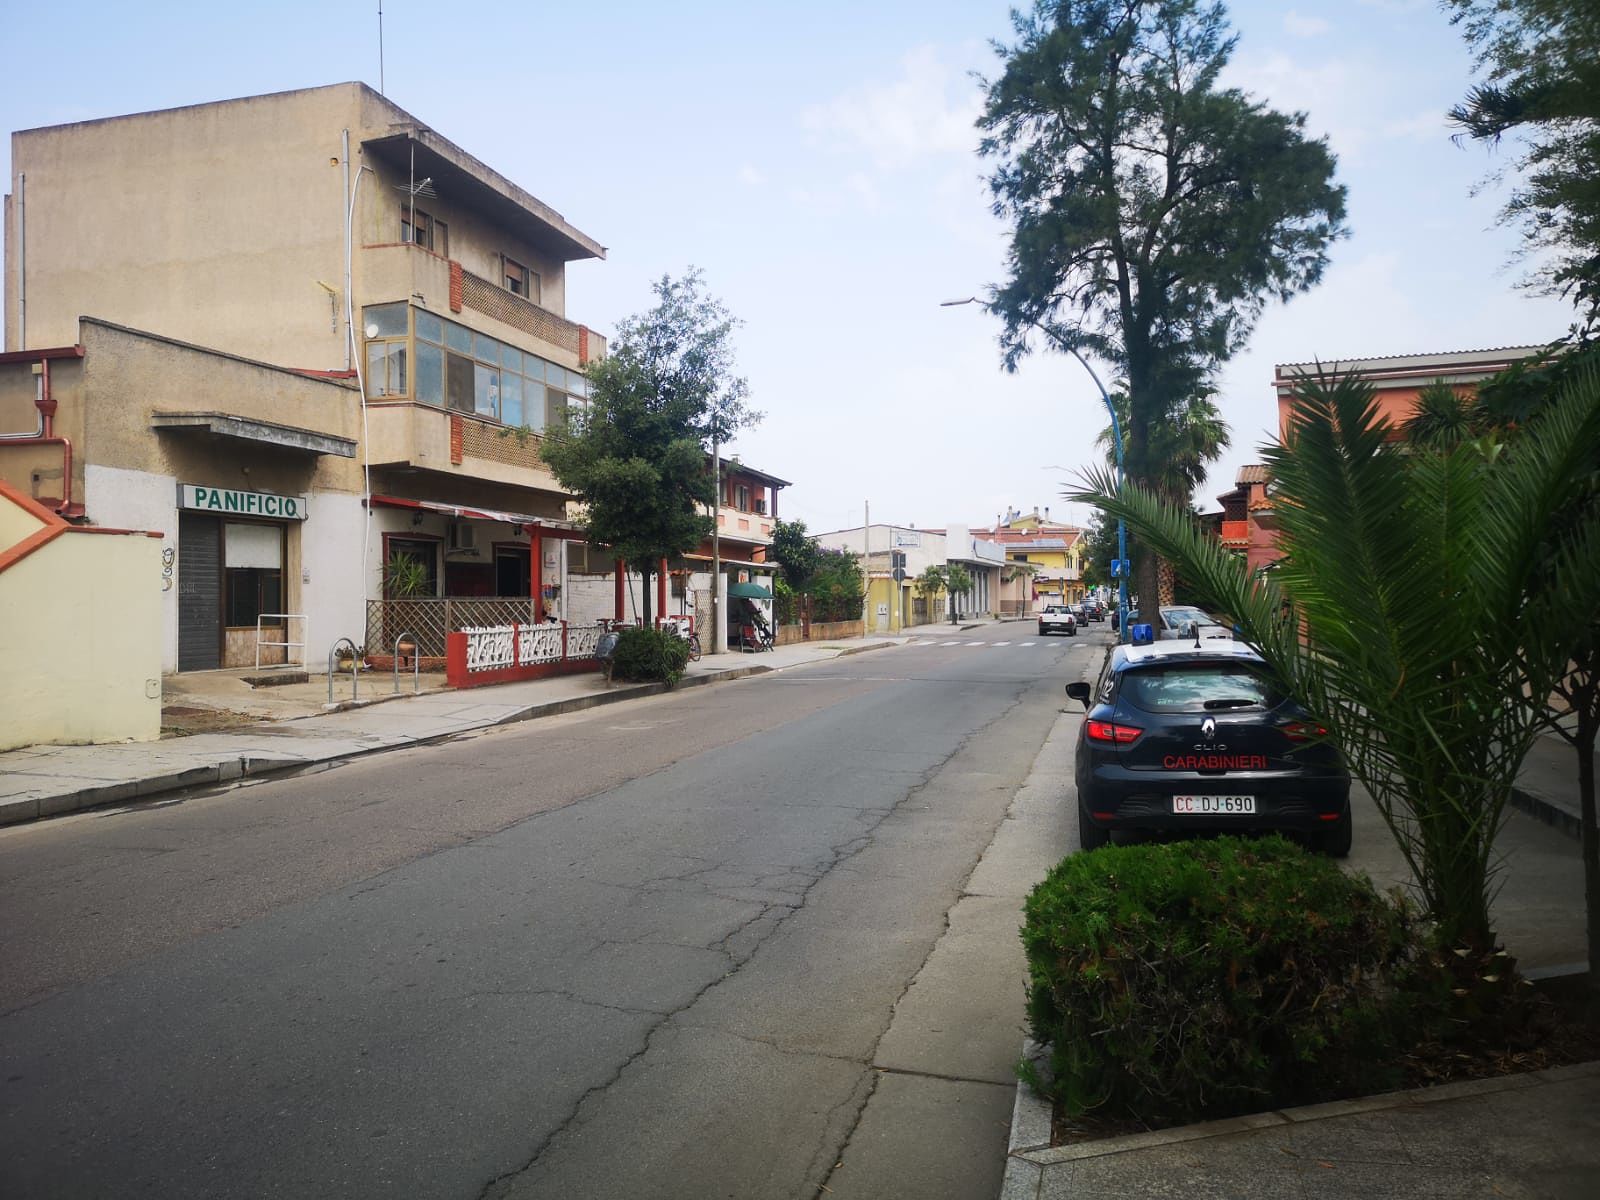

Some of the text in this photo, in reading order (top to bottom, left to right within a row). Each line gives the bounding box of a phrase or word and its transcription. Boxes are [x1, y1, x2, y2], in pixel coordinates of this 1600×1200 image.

[195, 487, 297, 517] PANIFICIO
[1163, 755, 1267, 769] CARABINIERI
[1175, 797, 1252, 811] CC DJ 690
